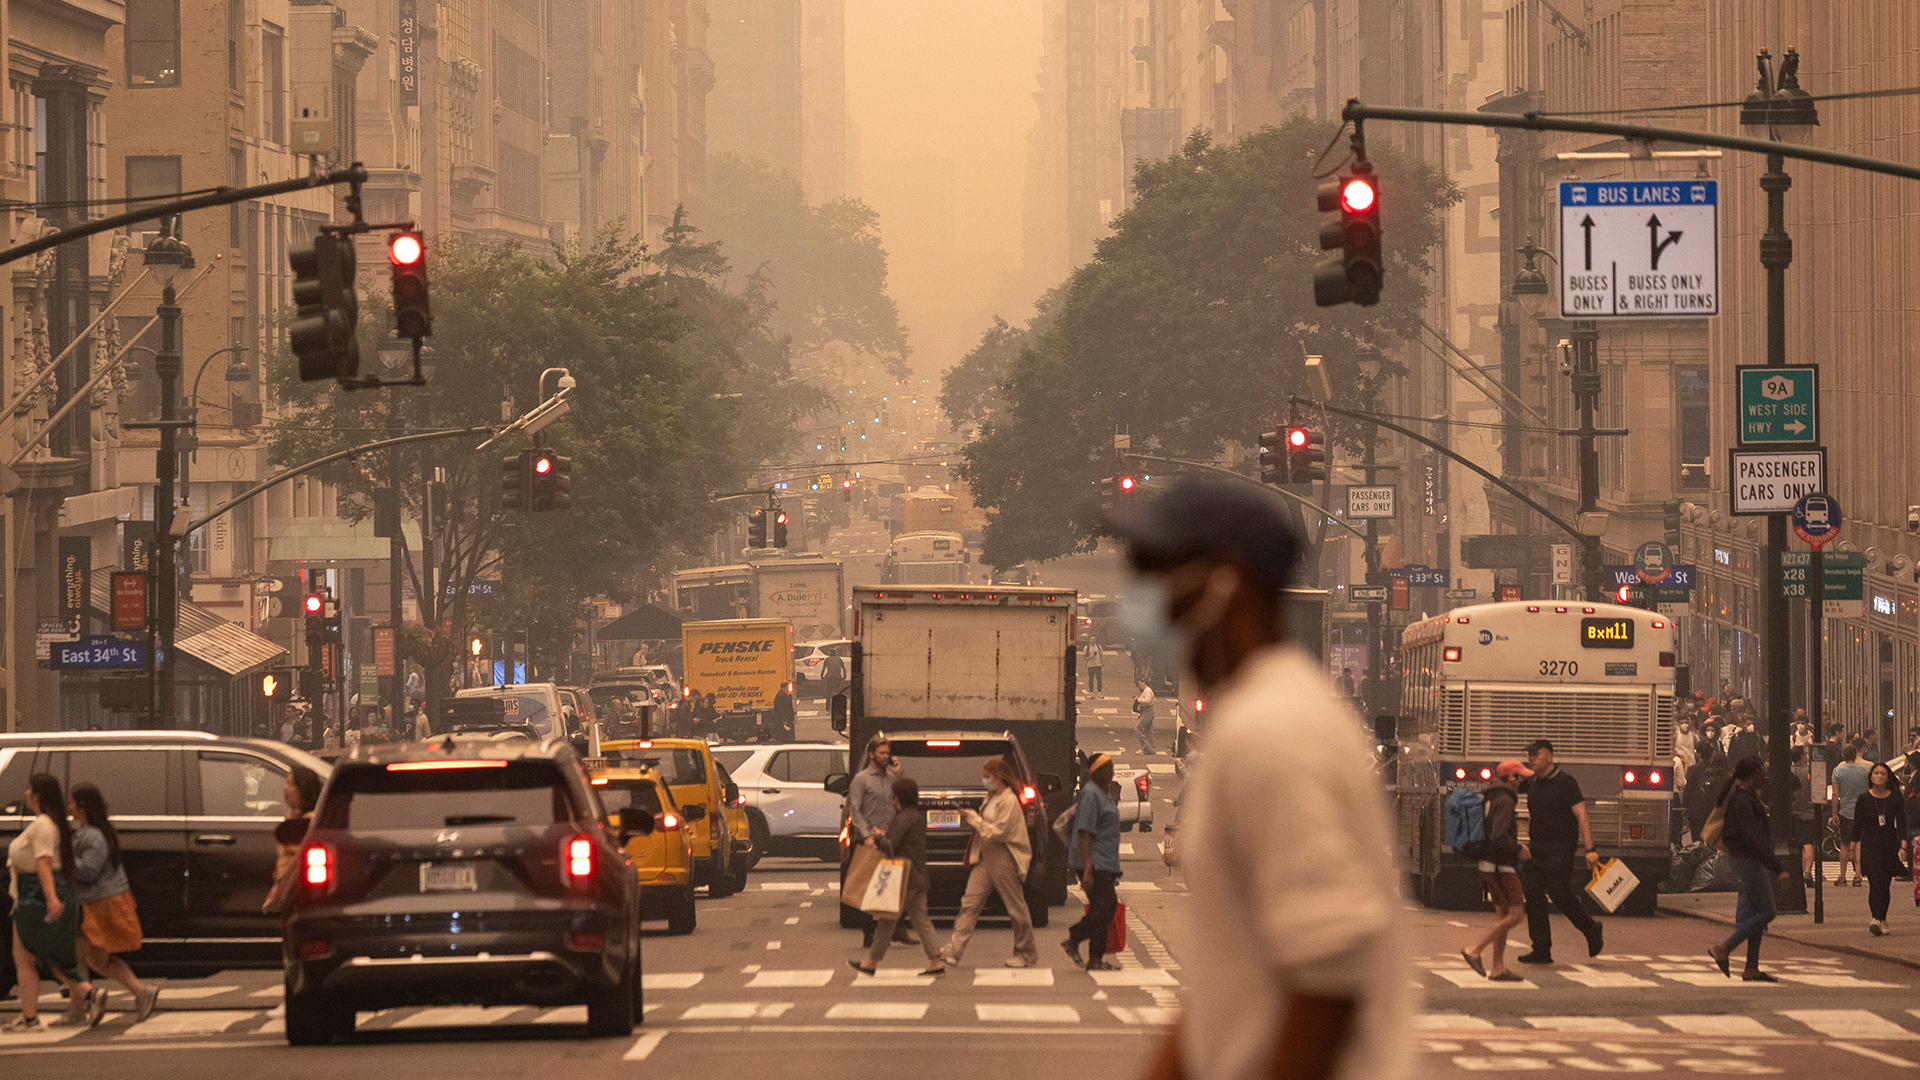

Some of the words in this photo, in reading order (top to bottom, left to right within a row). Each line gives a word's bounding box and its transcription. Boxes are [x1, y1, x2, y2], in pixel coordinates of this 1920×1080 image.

[401, 18, 414, 91] 청담병원
[1598, 187, 1628, 203] BUS
[1633, 186, 1681, 202] LANES
[1570, 276, 1608, 291] BUSES
[1629, 275, 1667, 290] BUSES
[1671, 274, 1703, 290] ONLY
[1573, 295, 1605, 310] ONLY
[1619, 295, 1629, 310] &
[1634, 294, 1669, 310] RIGHT
[1674, 294, 1713, 309] TURNS
[1767, 382, 1788, 395] 9A
[1748, 404, 1777, 416] WEST
[1783, 403, 1808, 416] SIDE
[1748, 421, 1772, 434] HWY
[1741, 461, 1816, 479] PASSENGER
[1352, 491, 1391, 500] PASSENGER
[1741, 484, 1774, 501] CARS
[1351, 503, 1370, 512] CARS
[1374, 502, 1391, 511] ONLY
[1806, 528, 1838, 543] STANDING
[1556, 547, 1568, 580] GNC
[64, 554, 76, 609] everything.
[1415, 573, 1432, 583] 33rd
[1434, 574, 1444, 583] St
[1614, 571, 1641, 584] Wes
[1675, 571, 1688, 584] St
[1784, 569, 1806, 581] x28
[74, 569, 84, 609] always.
[483, 585, 492, 594] St
[1784, 584, 1806, 596] x38
[876, 613, 884, 621] 2
[1048, 616, 1057, 624] 2
[1587, 622, 1629, 640] BxM11
[698, 640, 775, 654] PENSKE
[62, 649, 91, 663] East
[93, 648, 119, 662] 34th
[122, 648, 138, 662] St
[715, 655, 734, 663] Truck
[1539, 660, 1579, 676] 3270
[1606, 876, 1624, 896] MoMA
[1452, 1056, 1785, 1075] BUS
